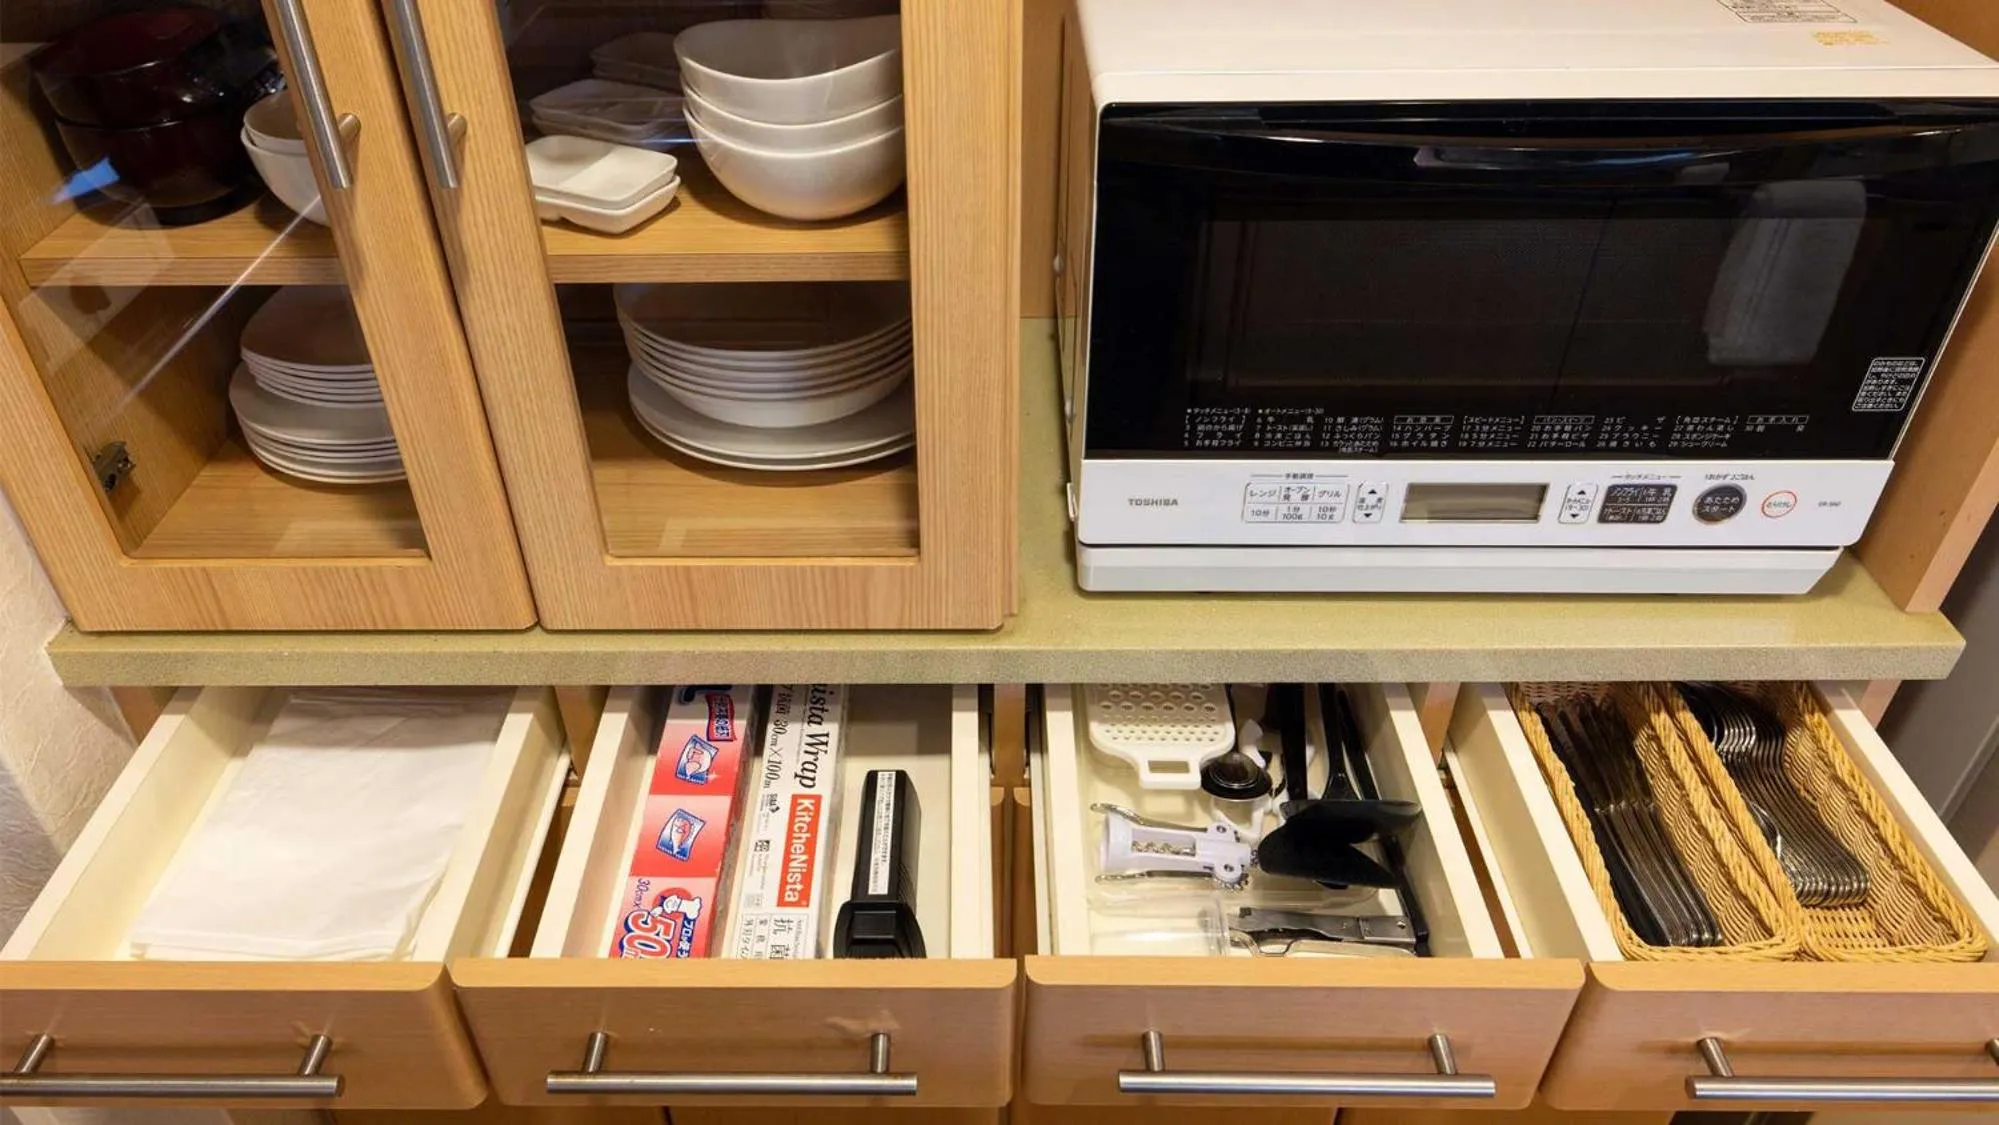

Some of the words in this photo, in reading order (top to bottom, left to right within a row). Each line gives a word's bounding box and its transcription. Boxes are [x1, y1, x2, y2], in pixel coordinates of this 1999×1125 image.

[1128, 498, 1179, 506] TOSHIBA
[794, 731, 830, 789] Wrap
[783, 798, 815, 903] KitcheNista
